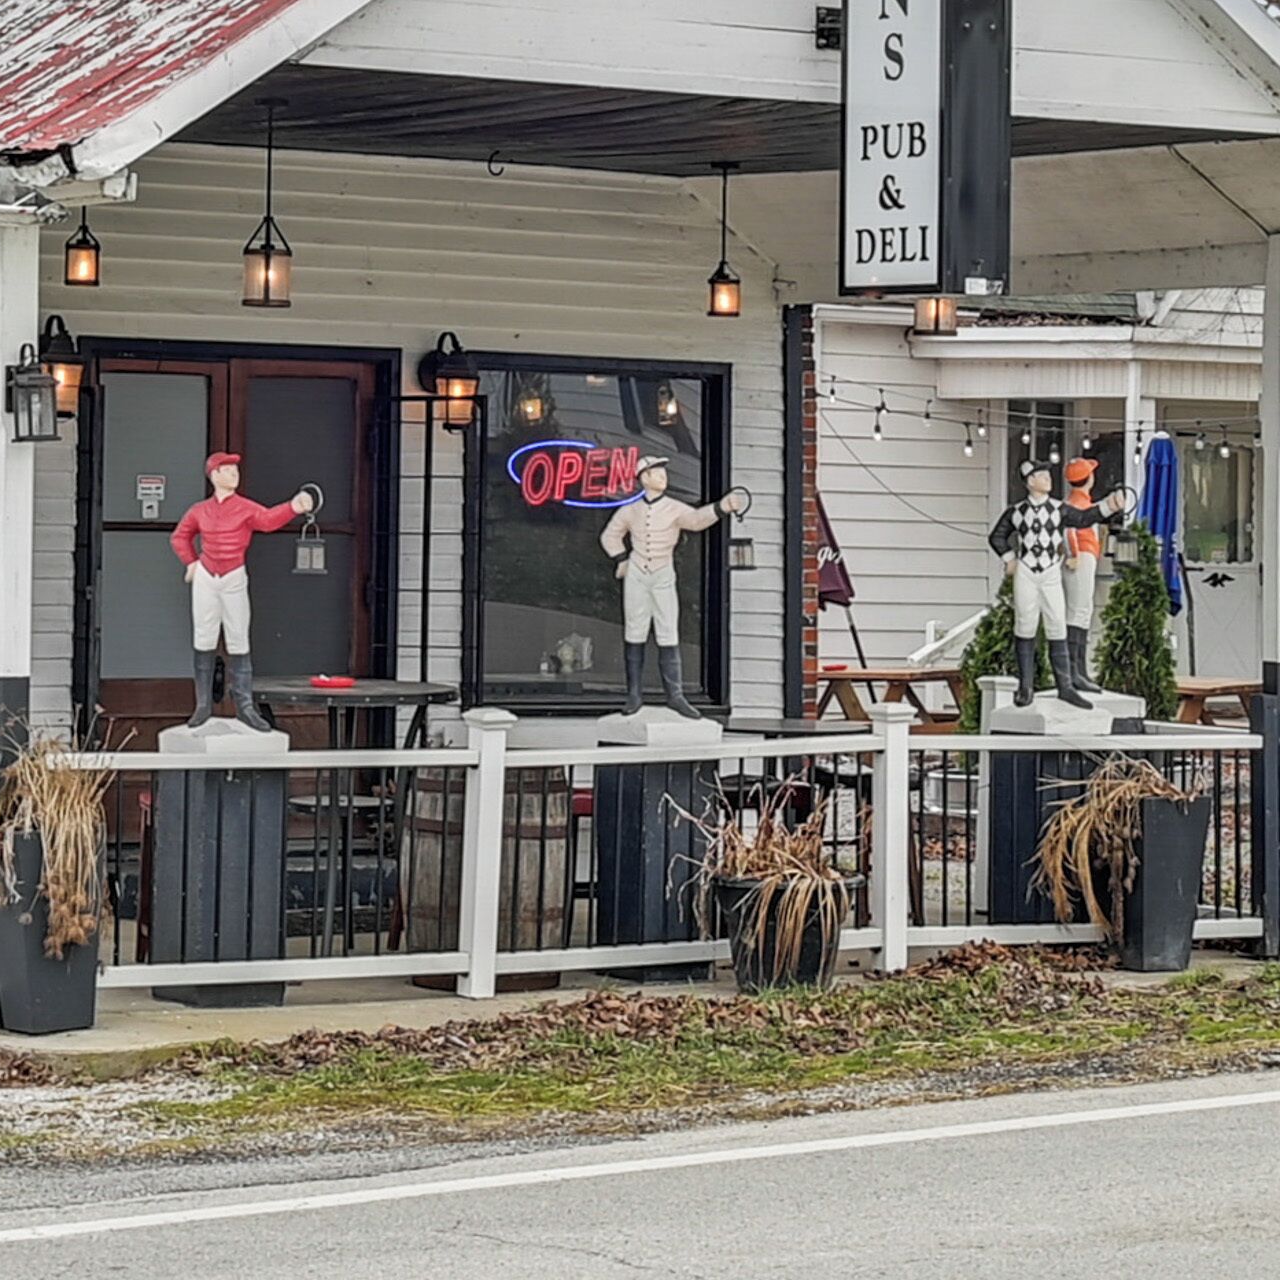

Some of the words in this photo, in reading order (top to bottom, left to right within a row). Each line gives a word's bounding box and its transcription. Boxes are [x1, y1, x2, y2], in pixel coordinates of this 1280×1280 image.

[860, 121, 927, 161] PUB
[878, 174, 906, 210] &
[855, 225, 929, 264] DELI
[522, 446, 639, 506] OPEN
